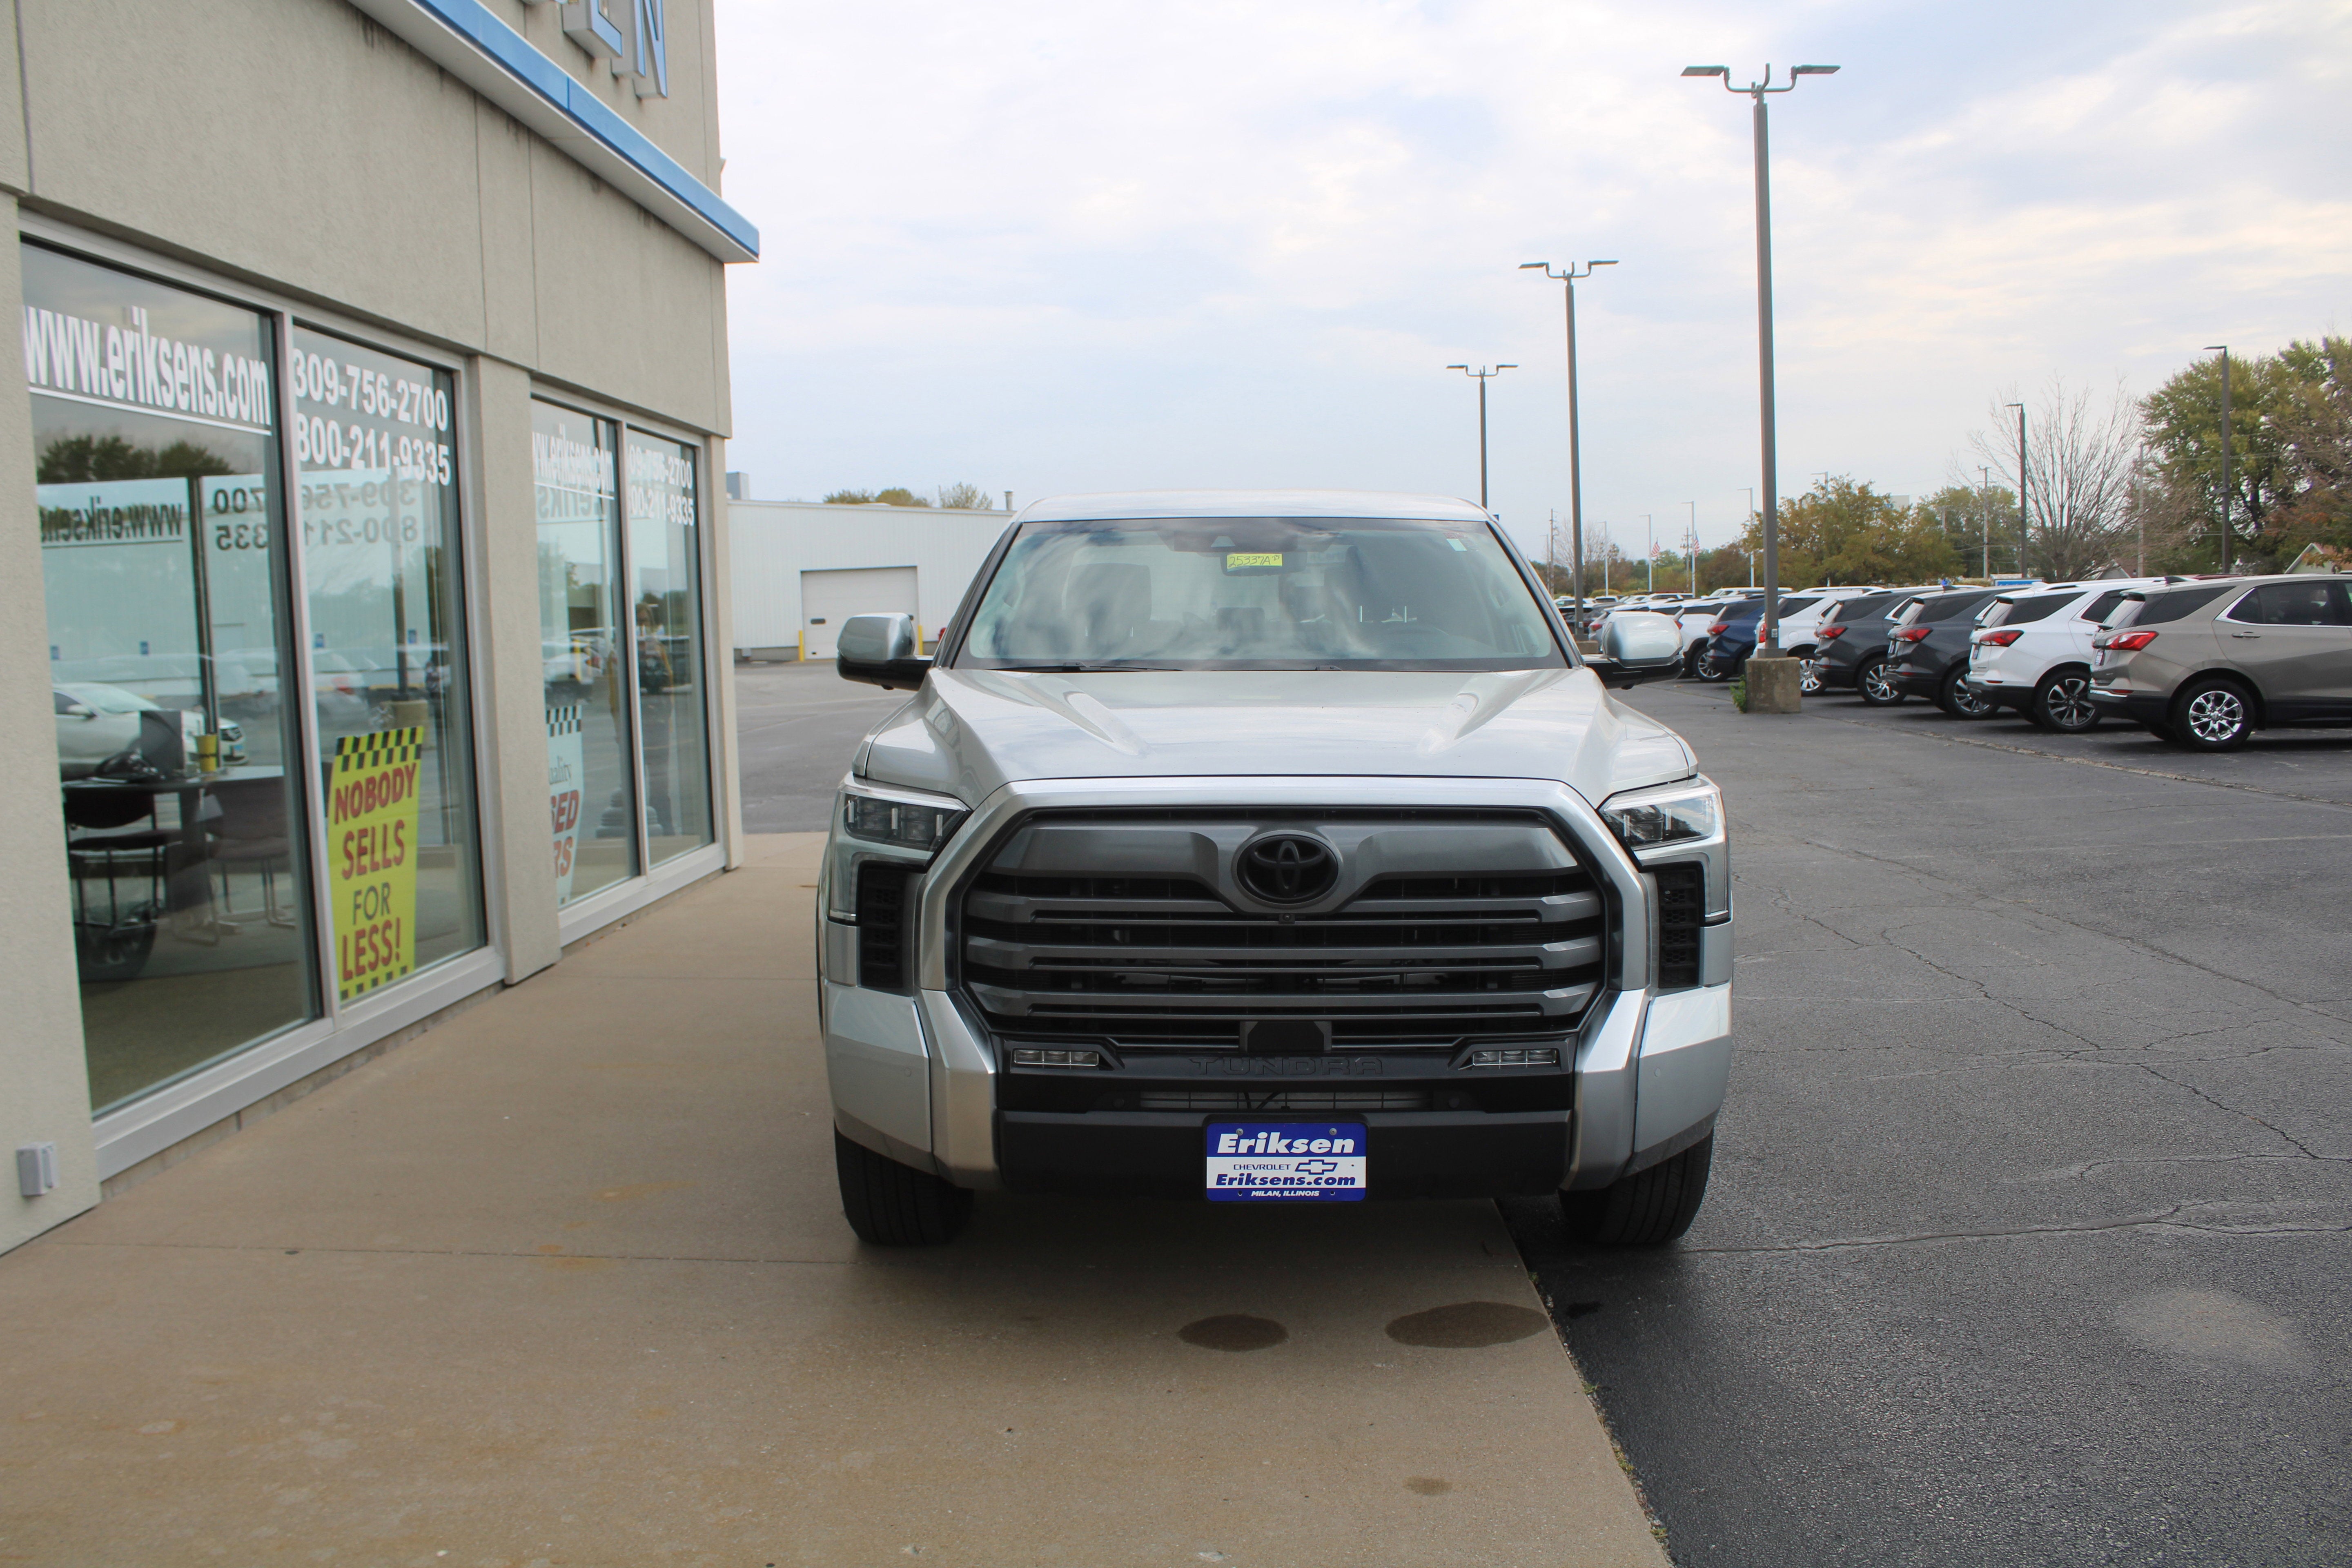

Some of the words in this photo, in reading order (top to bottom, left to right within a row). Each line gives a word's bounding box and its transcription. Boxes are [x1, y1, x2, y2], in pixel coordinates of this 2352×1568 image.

[24, 305, 272, 425] www.eriksens.com
[292, 348, 448, 432] 309-756-2700
[296, 412, 451, 486] 800-211-9335
[629, 443, 693, 490] 09-756-2700
[629, 484, 694, 527] 00-211-9335
[1228, 555, 1271, 568] 25337A
[334, 762, 416, 825] NOBODY
[342, 819, 405, 880] SELLS
[353, 882, 390, 926] FOR
[342, 917, 400, 982] LESS!
[1189, 1057, 1383, 1075] TUNDRA
[1217, 1132, 1354, 1154] Eriksen
[1216, 1173, 1356, 1186] Eriksens.com
